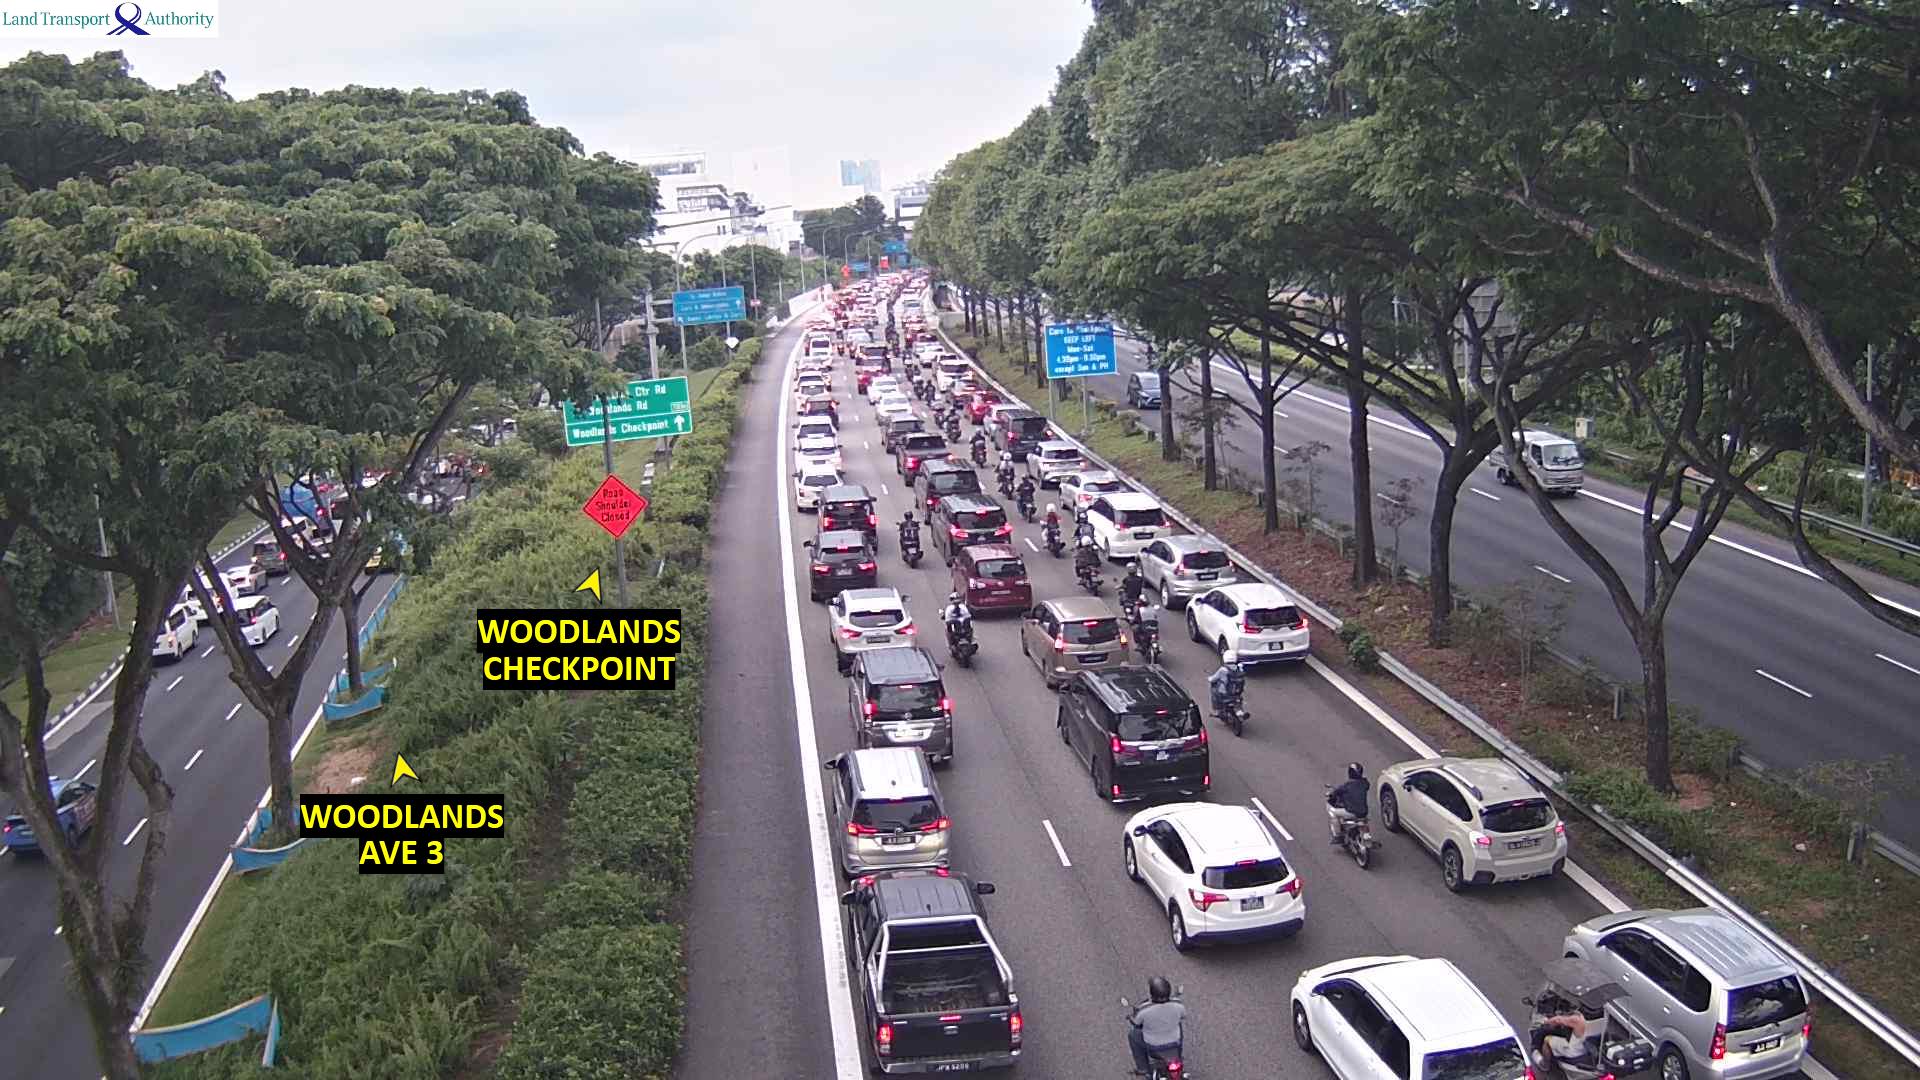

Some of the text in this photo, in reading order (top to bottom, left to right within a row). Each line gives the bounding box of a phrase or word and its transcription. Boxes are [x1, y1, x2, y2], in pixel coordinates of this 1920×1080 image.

[635, 386, 650, 397] Ctr
[655, 384, 666, 394] Rd
[637, 400, 648, 410] Rd
[621, 419, 669, 433] Checkpoint
